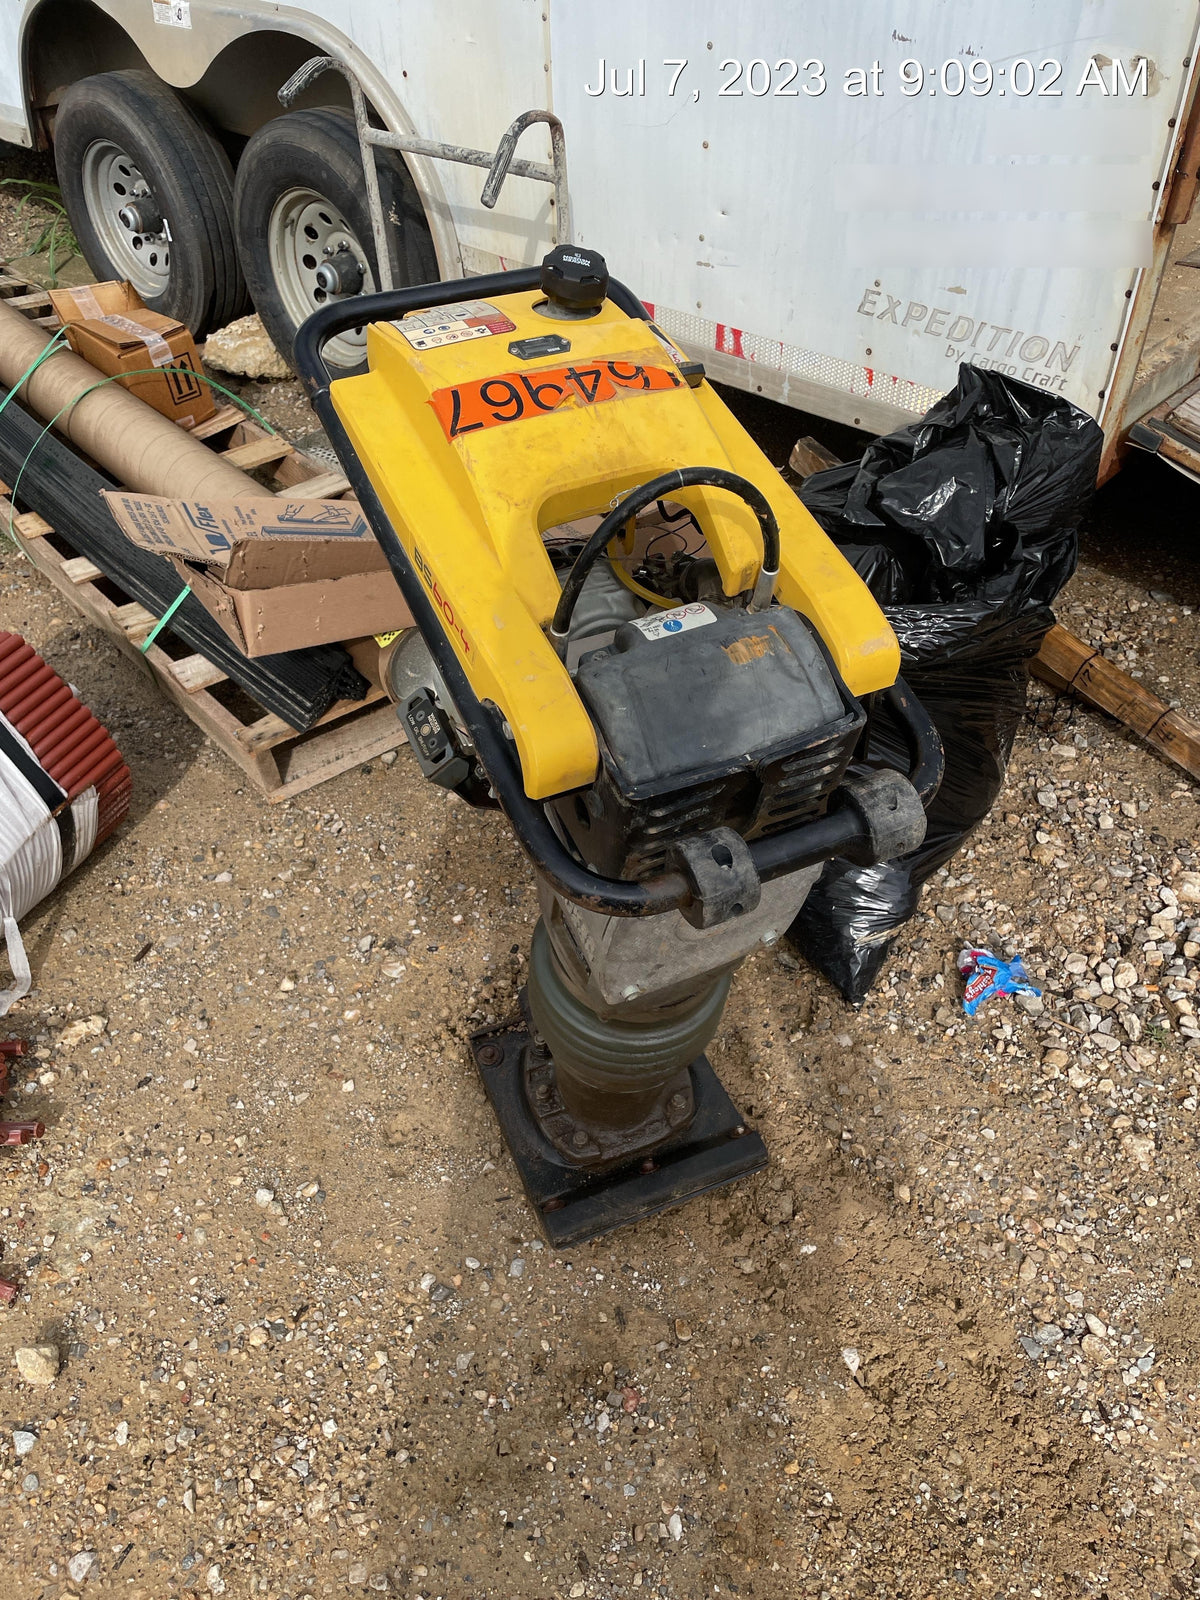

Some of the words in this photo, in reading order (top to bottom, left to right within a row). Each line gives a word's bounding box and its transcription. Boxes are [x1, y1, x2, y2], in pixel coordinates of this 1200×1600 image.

[857, 288, 1081, 373] EXPEDITION
[944, 345, 965, 363] by
[969, 352, 1018, 376] Cargo
[1022, 367, 1069, 391] Craft
